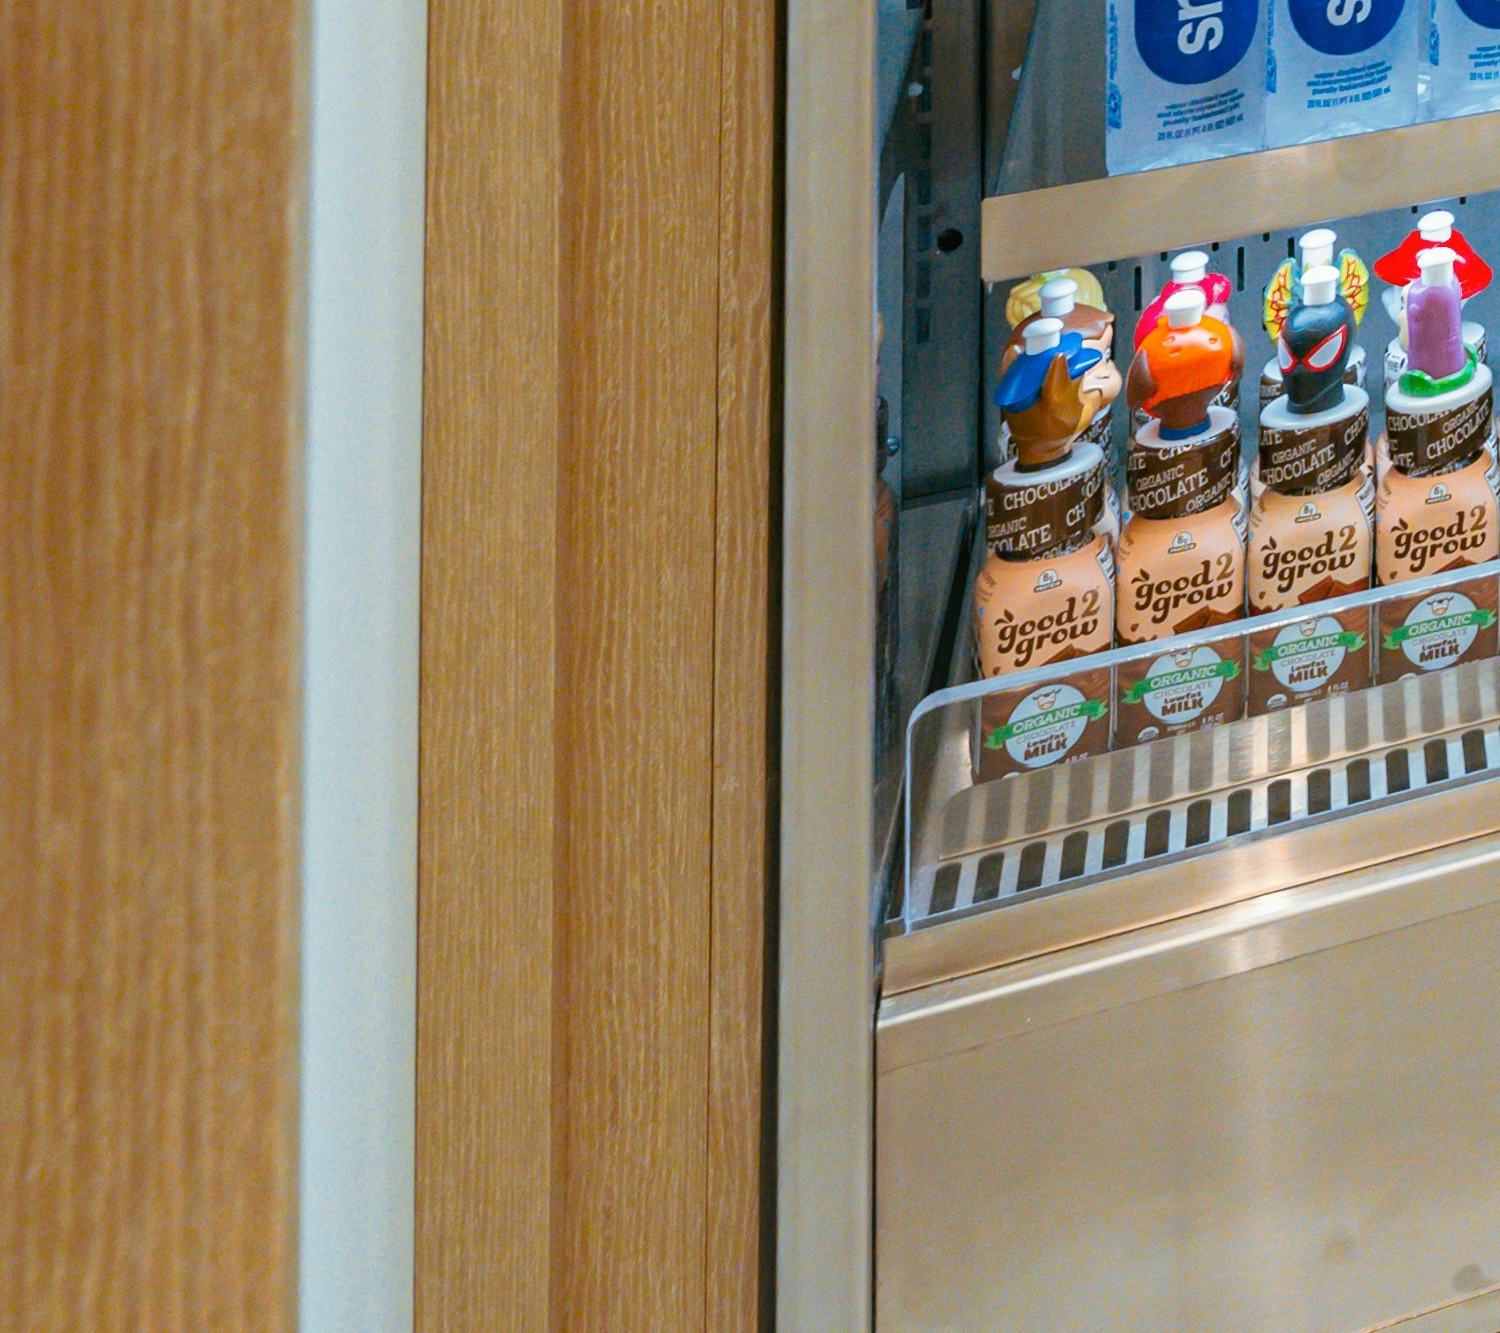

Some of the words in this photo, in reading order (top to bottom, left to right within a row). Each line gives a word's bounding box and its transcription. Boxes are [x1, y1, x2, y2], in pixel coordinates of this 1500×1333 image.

[1427, 405, 1490, 460] CHOCOLATE
[1136, 466, 1184, 491] ORGANIC
[1262, 531, 1334, 579] good
[1338, 525, 1358, 550] 2
[1278, 549, 1356, 593] grow
[1135, 561, 1212, 610] good
[1216, 553, 1236, 580] 2
[1152, 579, 1234, 624] grow
[998, 597, 1076, 654] good
[1080, 590, 1100, 618] 2
[1015, 618, 1098, 667] grow
[1278, 634, 1340, 658] ORGANIC
[1288, 664, 1329, 685] MILK
